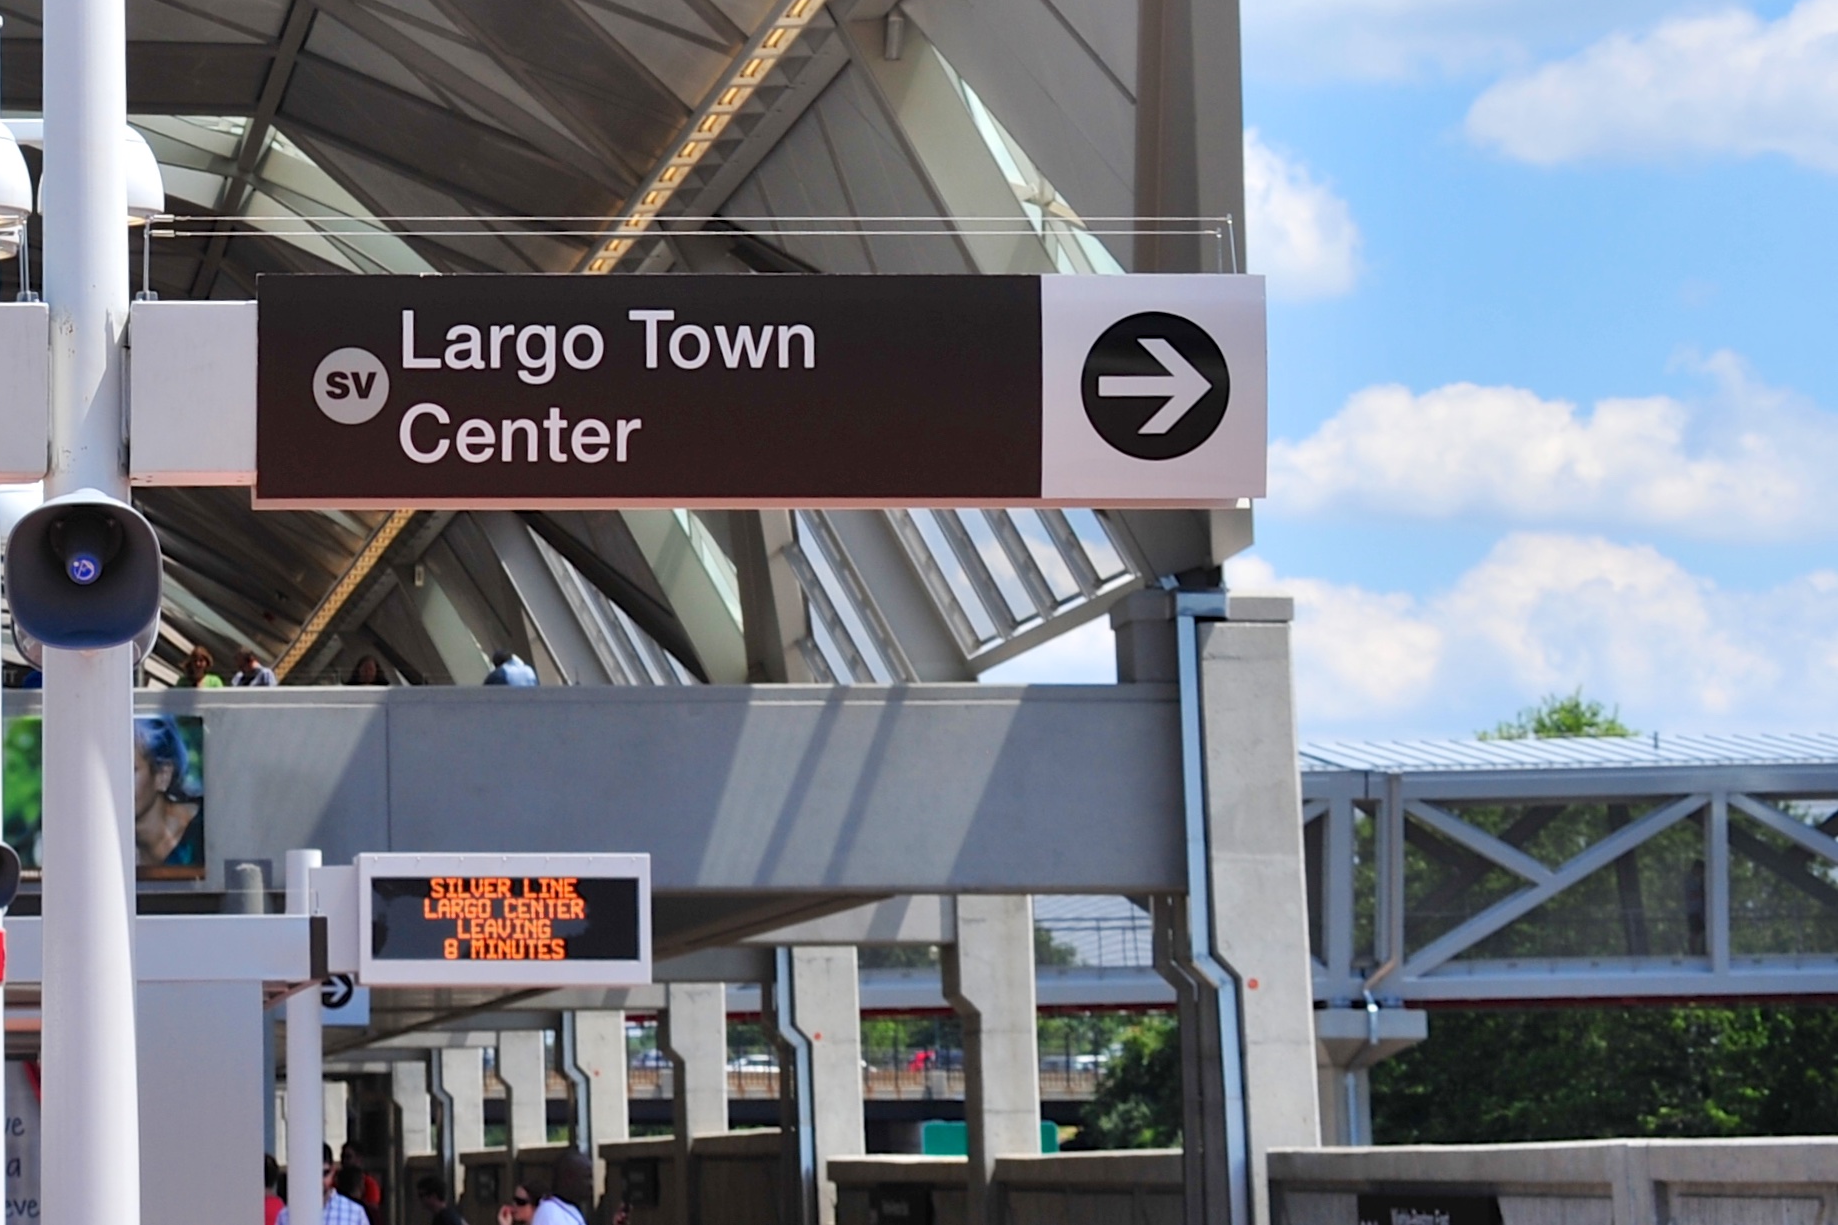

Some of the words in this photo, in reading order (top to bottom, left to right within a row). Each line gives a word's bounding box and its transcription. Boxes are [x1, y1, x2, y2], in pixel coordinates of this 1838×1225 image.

[401, 309, 604, 385] Largo
[629, 309, 816, 370] Town
[325, 371, 377, 400] SV
[399, 403, 641, 463] Center
[430, 878, 511, 899] SILVER
[523, 878, 578, 899] LINE
[423, 898, 492, 919] LARGO
[503, 898, 585, 919] CENTER
[457, 918, 552, 939] LEAVING
[444, 938, 459, 960] 8
[470, 938, 565, 960] MINUTES
